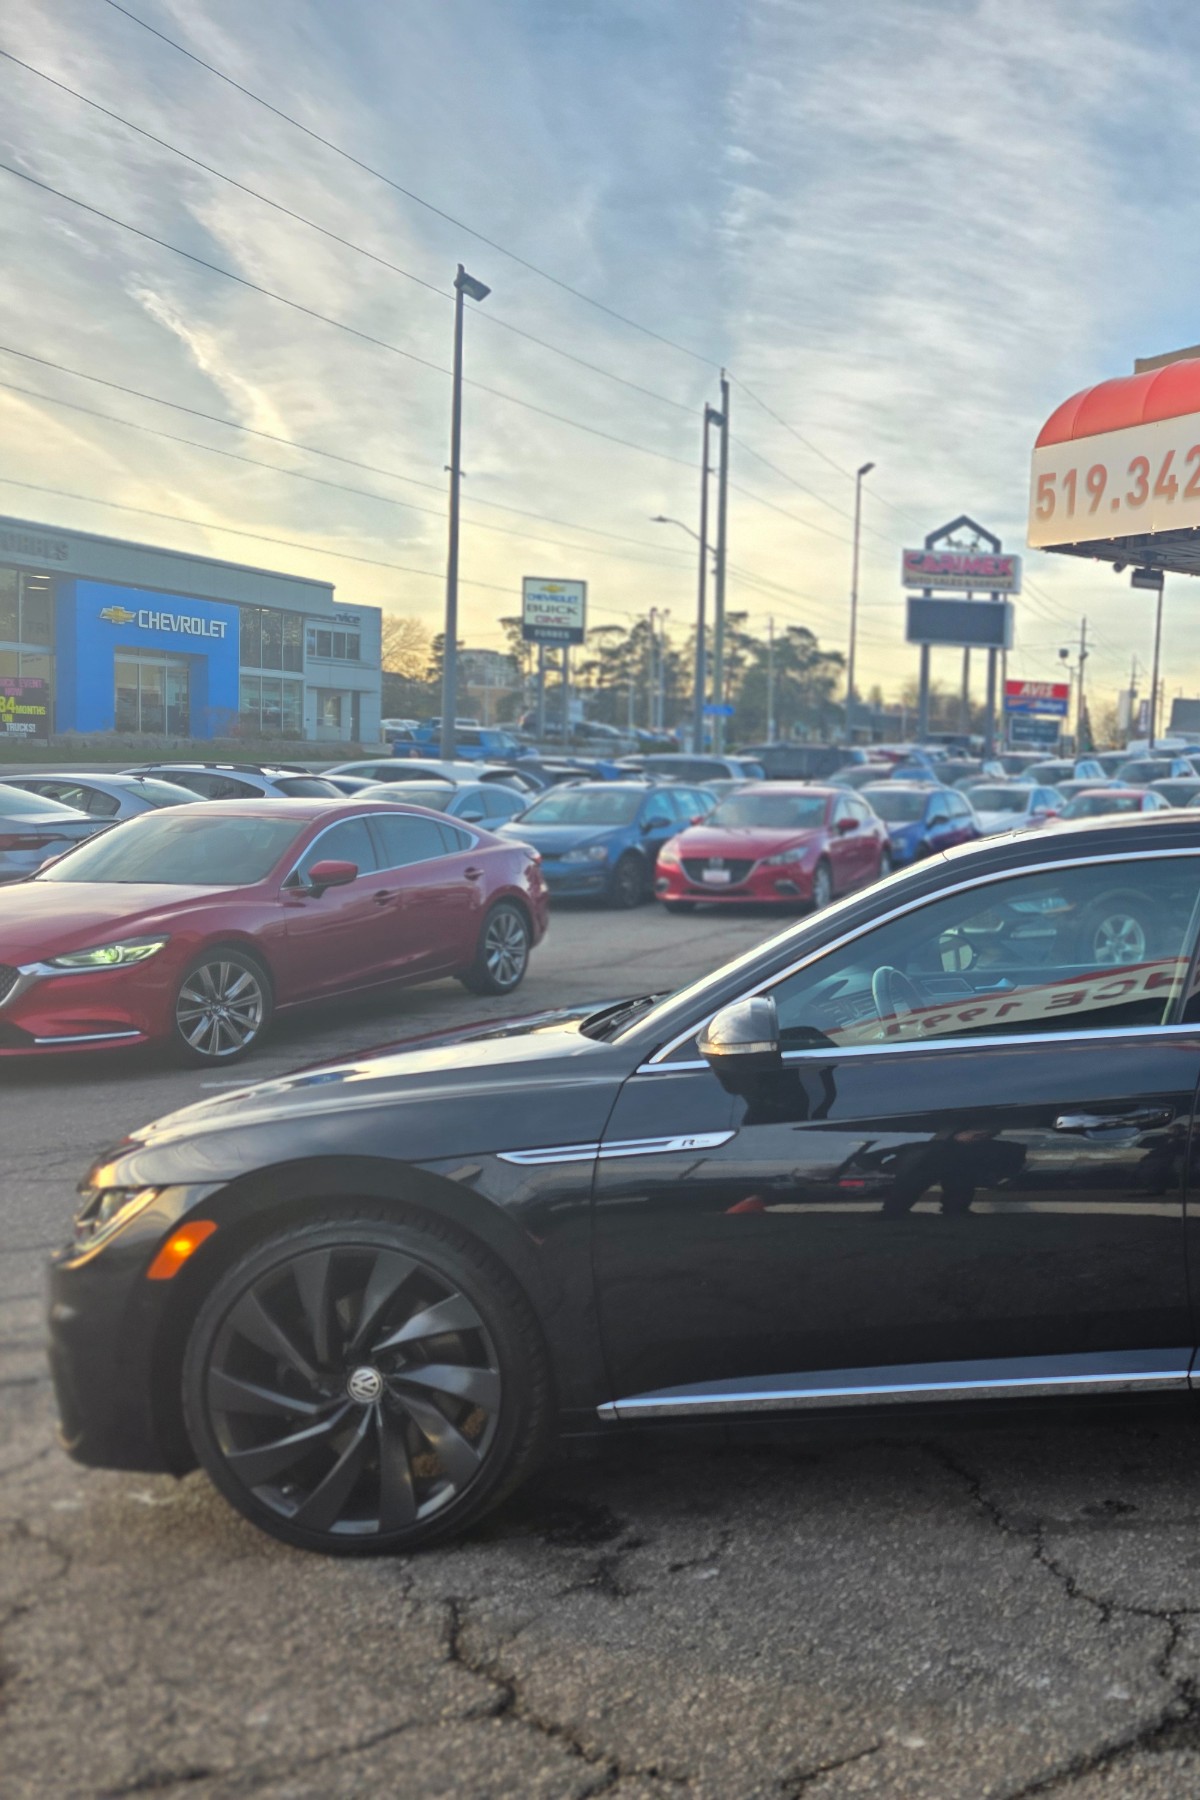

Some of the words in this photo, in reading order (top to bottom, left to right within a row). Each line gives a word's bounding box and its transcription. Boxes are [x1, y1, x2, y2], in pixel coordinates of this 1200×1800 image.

[904, 552, 1014, 577] CARIMEX
[527, 593, 578, 603] CHEVROLET
[526, 603, 578, 615] BUICK
[138, 609, 228, 639] CHEVROLET
[1020, 683, 1054, 698] AVIS
[15, 705, 46, 715] MONTHS
